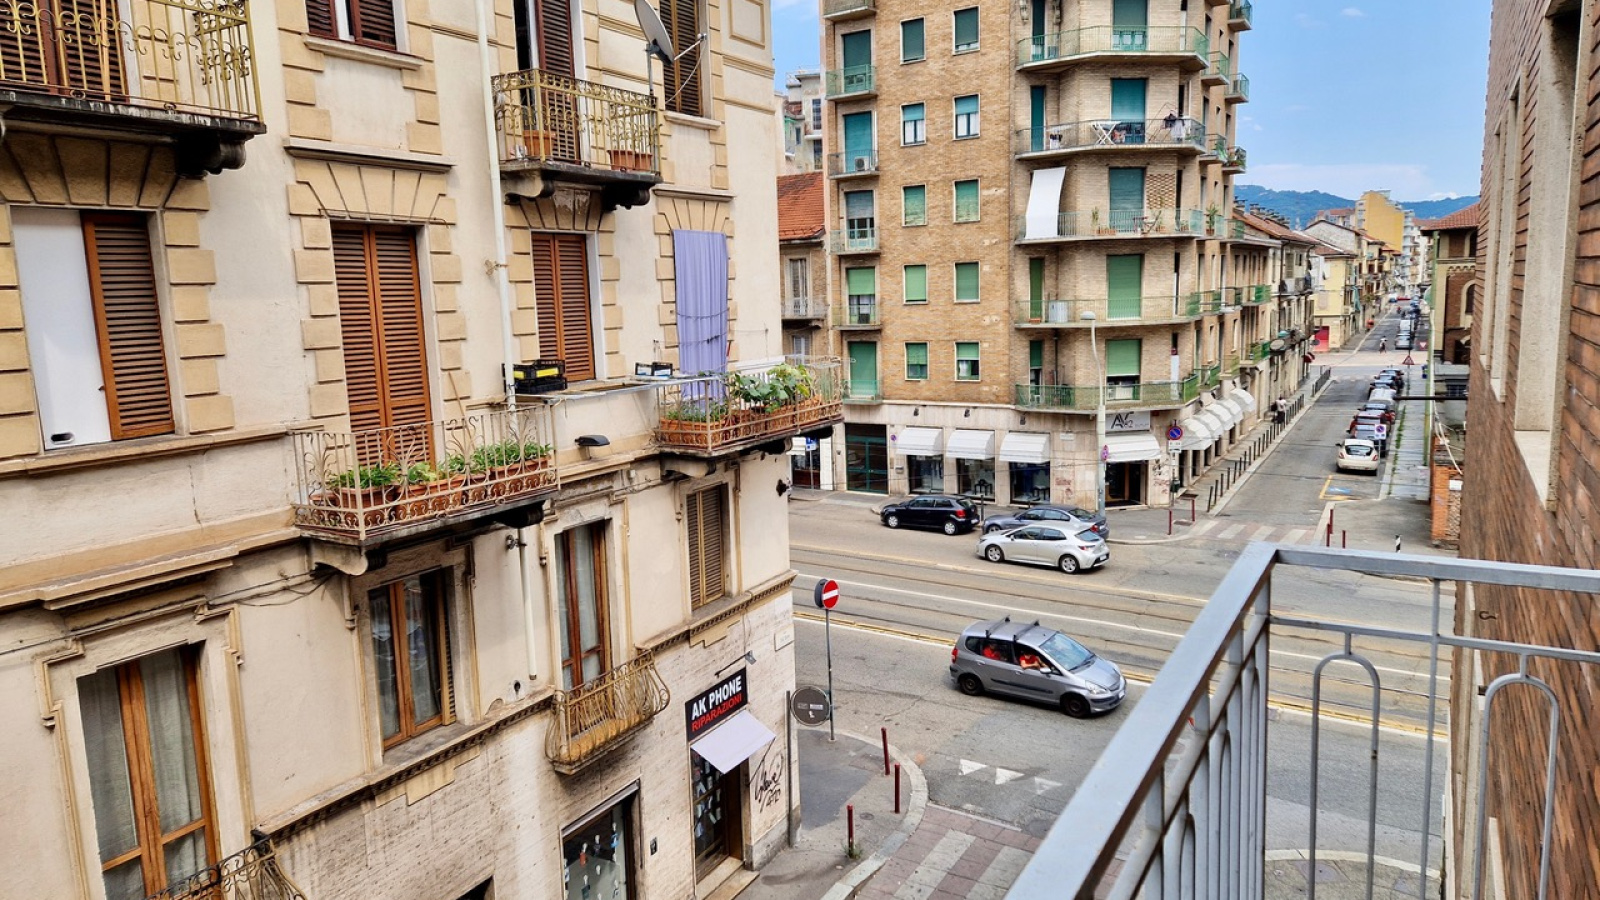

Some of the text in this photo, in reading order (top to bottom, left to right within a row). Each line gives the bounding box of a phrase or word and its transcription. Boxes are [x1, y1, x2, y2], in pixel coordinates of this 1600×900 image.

[691, 675, 742, 721] AK PHONE
[691, 692, 743, 732] RIPARAZIONI
